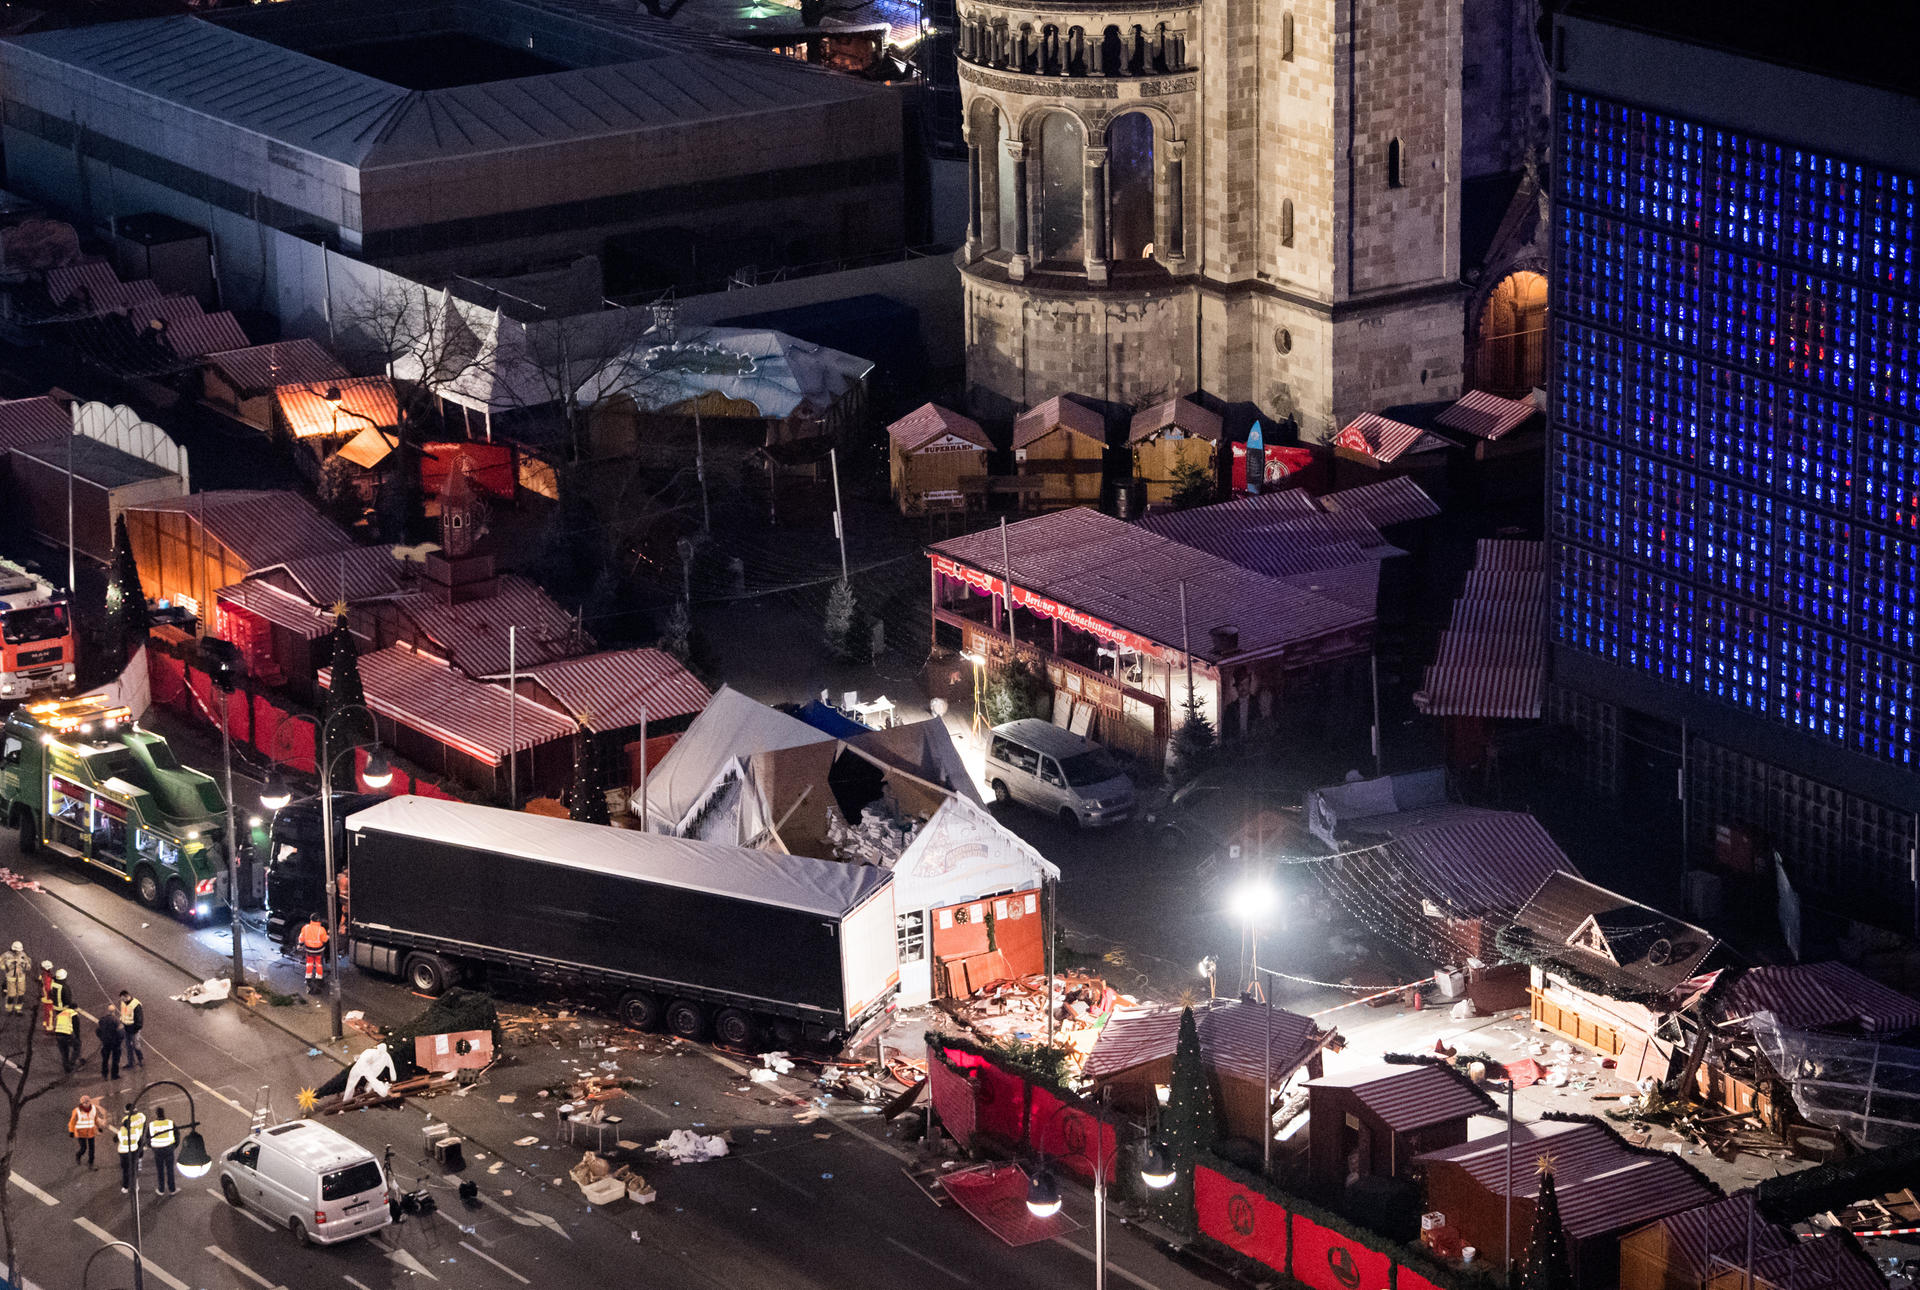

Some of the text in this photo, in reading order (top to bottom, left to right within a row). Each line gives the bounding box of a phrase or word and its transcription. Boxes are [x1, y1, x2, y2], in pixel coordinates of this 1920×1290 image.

[924, 444, 974, 453] SUPERHAHN
[1024, 591, 1127, 642] Berliner Weihnachtsterrasse
